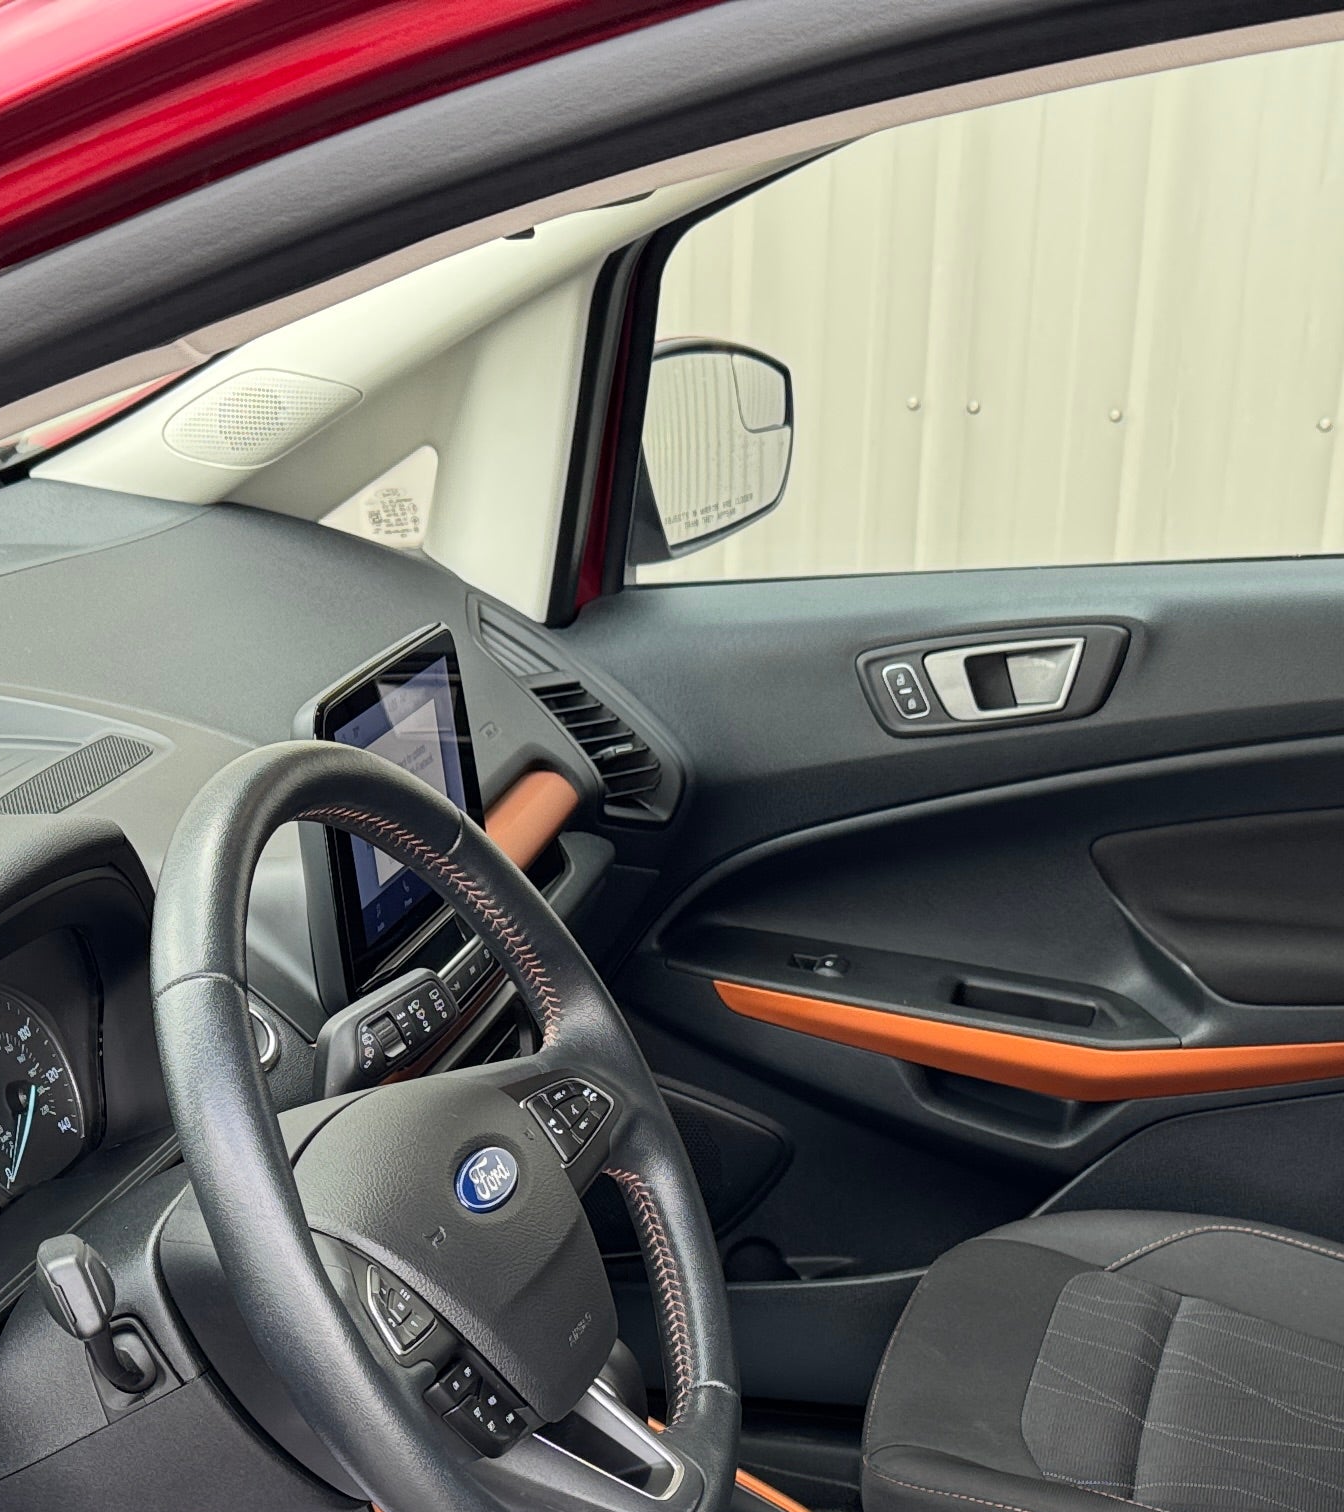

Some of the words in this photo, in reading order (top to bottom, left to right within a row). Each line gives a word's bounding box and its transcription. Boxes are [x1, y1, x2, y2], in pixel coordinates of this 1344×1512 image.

[17, 1025, 31, 1041] 100
[45, 1067, 59, 1084] 120
[58, 1116, 71, 1133] 140
[469, 1154, 511, 1200] Ford
